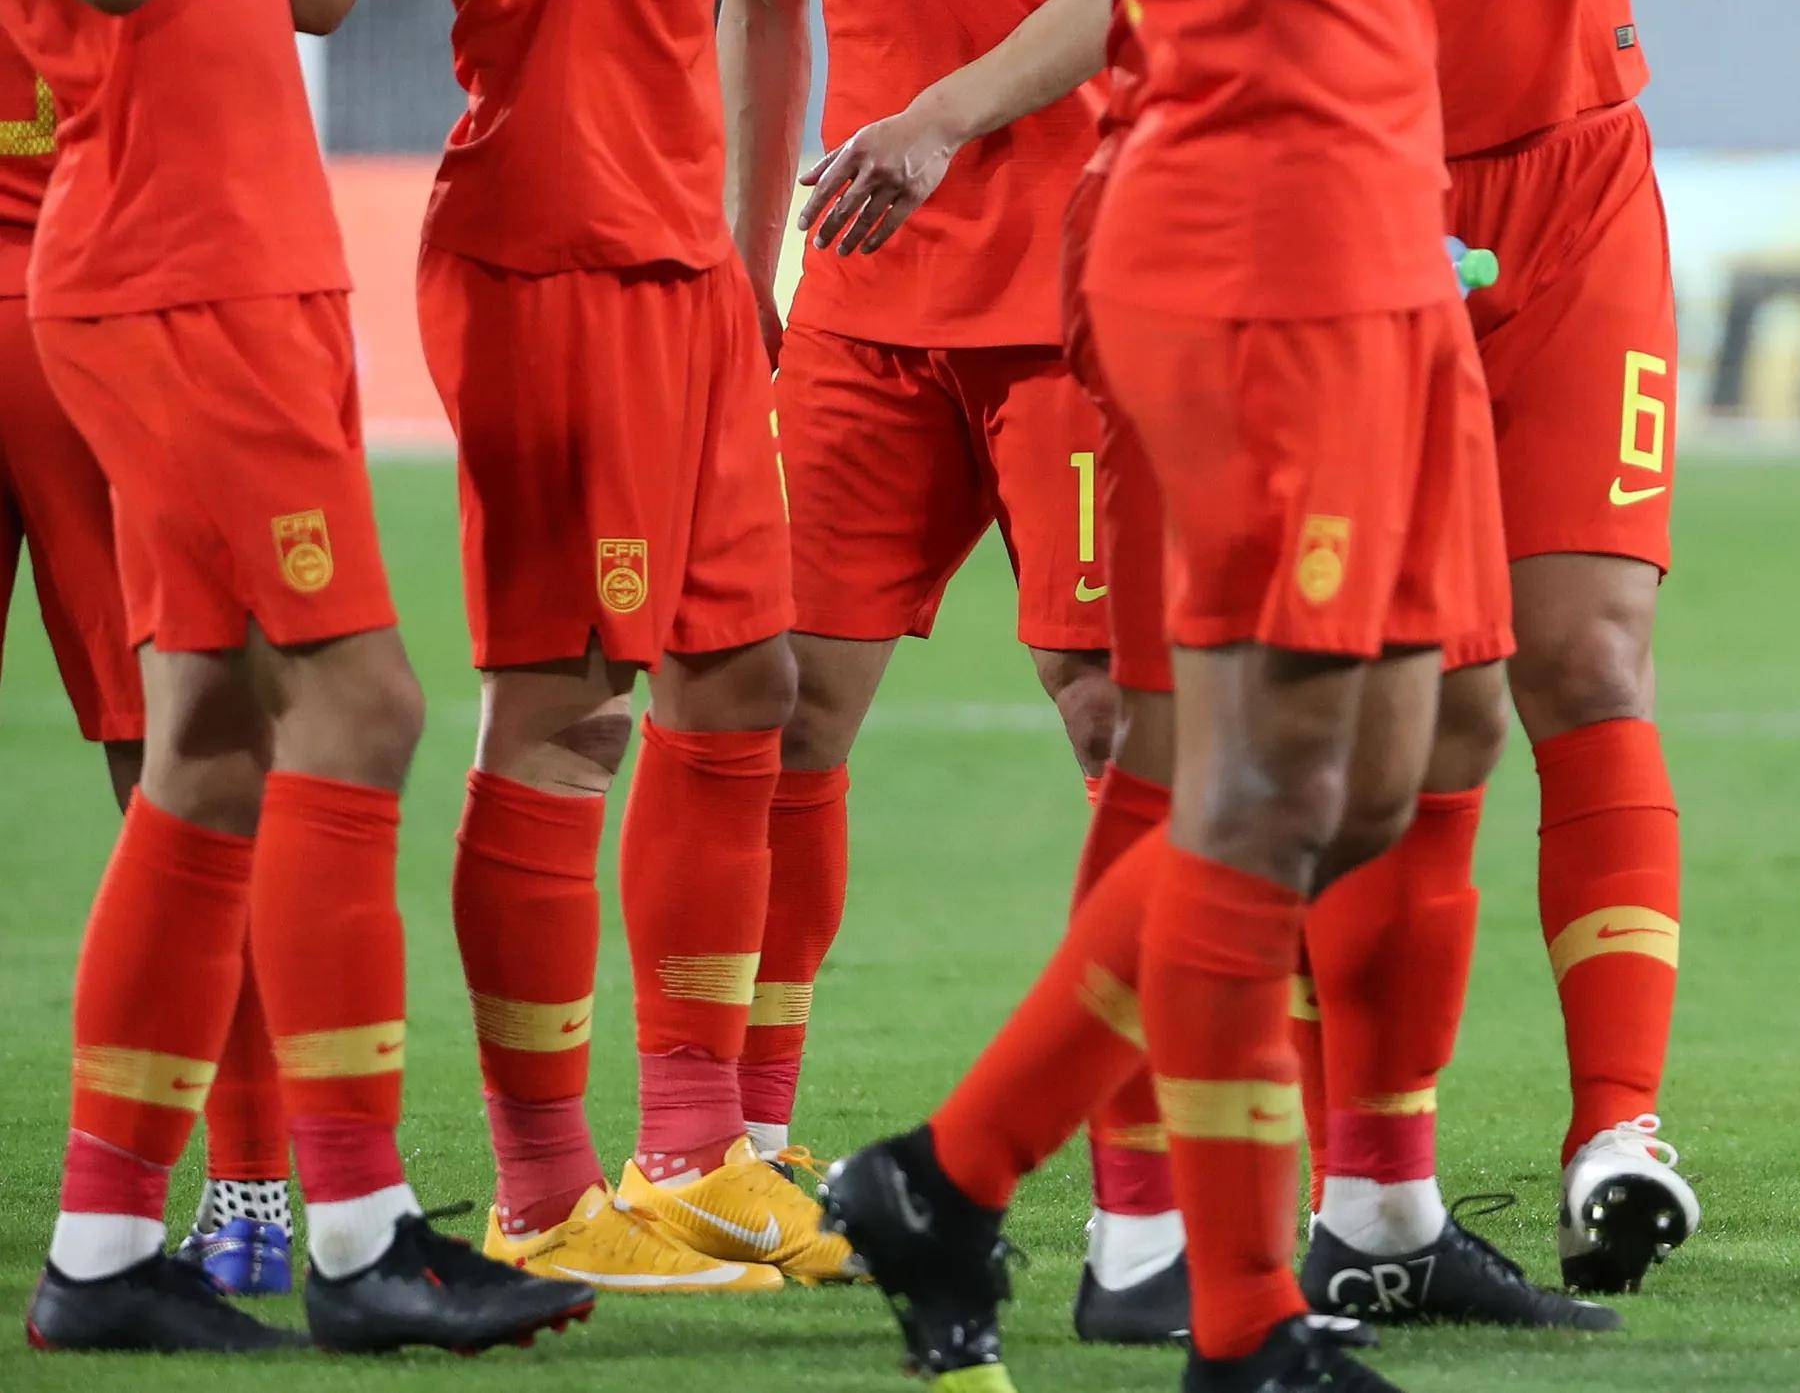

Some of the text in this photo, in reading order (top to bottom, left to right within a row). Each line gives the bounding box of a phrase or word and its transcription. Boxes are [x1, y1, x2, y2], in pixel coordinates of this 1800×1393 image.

[1620, 350, 1666, 473] 6
[602, 543, 643, 557] CFA
[1327, 1254, 1435, 1313] CR7
